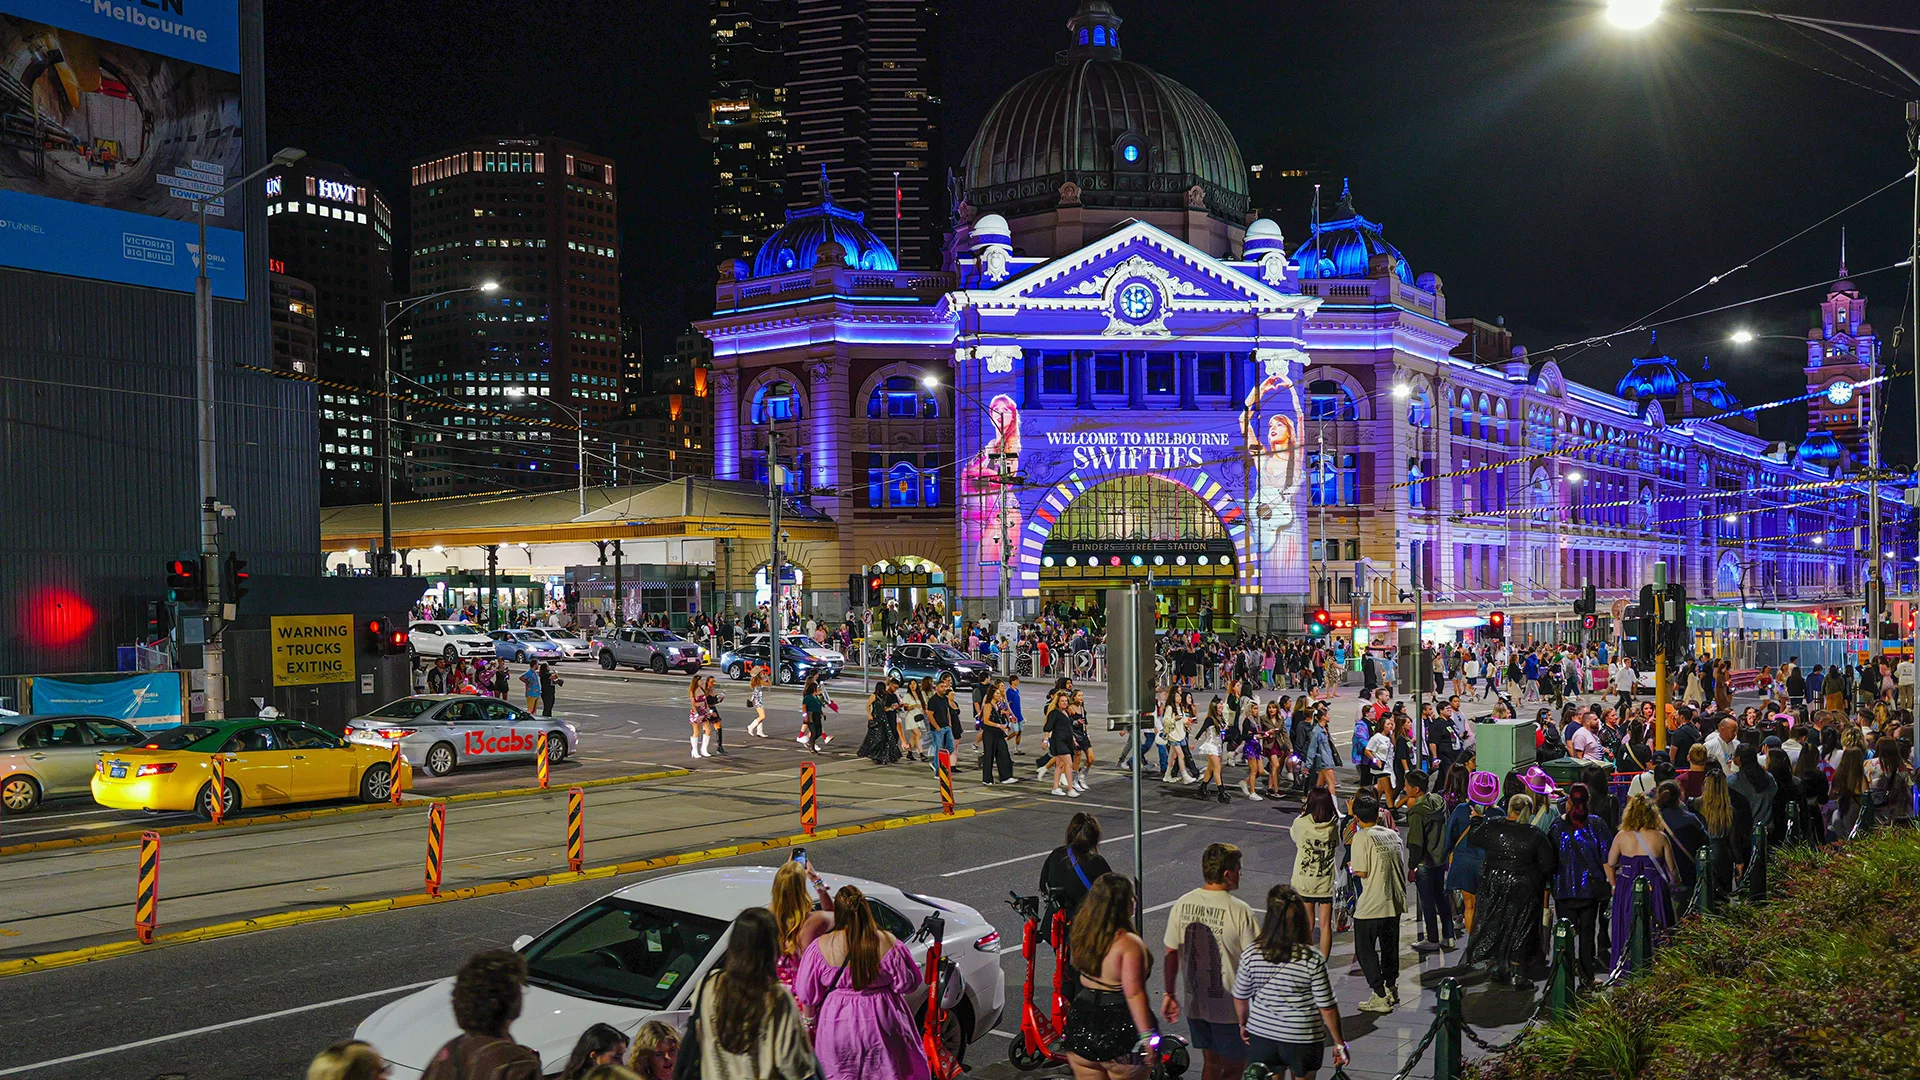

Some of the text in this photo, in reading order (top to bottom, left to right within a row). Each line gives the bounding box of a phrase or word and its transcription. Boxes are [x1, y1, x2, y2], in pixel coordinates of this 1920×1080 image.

[94, 0, 208, 43] Melbourne
[193, 161, 223, 174] ARDEN
[157, 175, 184, 187] STATE
[176, 168, 223, 183] PARKVILLE
[171, 188, 199, 201] TOWN
[318, 179, 356, 203] HWT
[193, 203, 224, 215] AZAC
[126, 236, 171, 250] VICTORIA'S
[127, 248, 171, 261] BIG BUILD
[1046, 432, 1230, 446] WELCOME TO MELBOURNE
[1073, 445, 1203, 470] SWIFTIES
[1072, 542, 1206, 551] FLINDERS STREET STATION
[278, 625, 348, 639] WARNING
[286, 643, 341, 656] TRUCKS
[287, 660, 342, 673] EXITING
[464, 728, 534, 756] 13cabs
[1181, 903, 1226, 920] TAYLOR SWIFT
